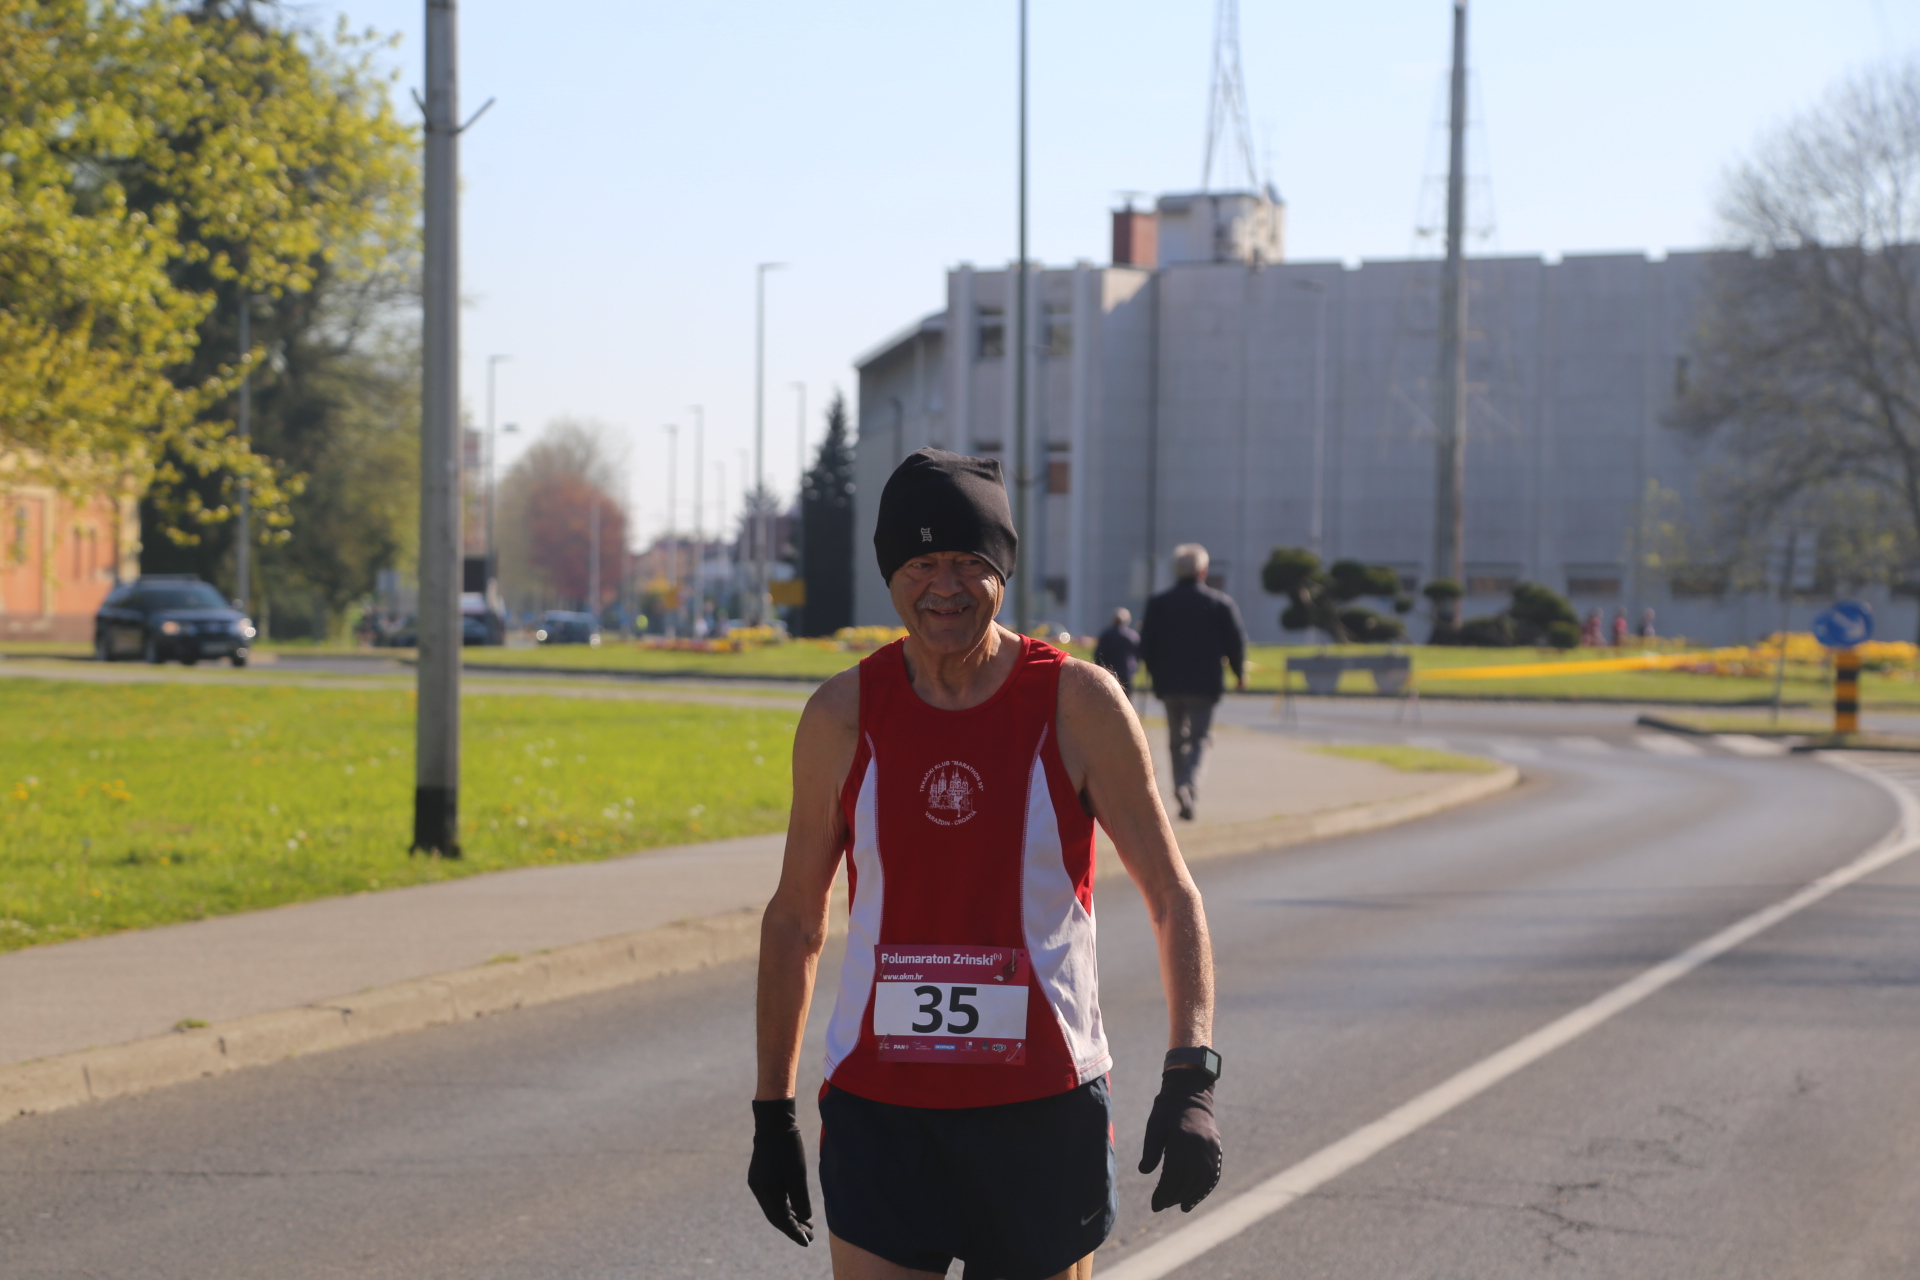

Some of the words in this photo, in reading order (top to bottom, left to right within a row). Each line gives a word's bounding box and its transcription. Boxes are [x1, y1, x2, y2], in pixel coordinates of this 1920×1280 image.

[934, 760, 950, 770] KLUB
[954, 811, 977, 826] CROATIA
[882, 952, 950, 964] Polumaraton
[912, 986, 979, 1034] 35
